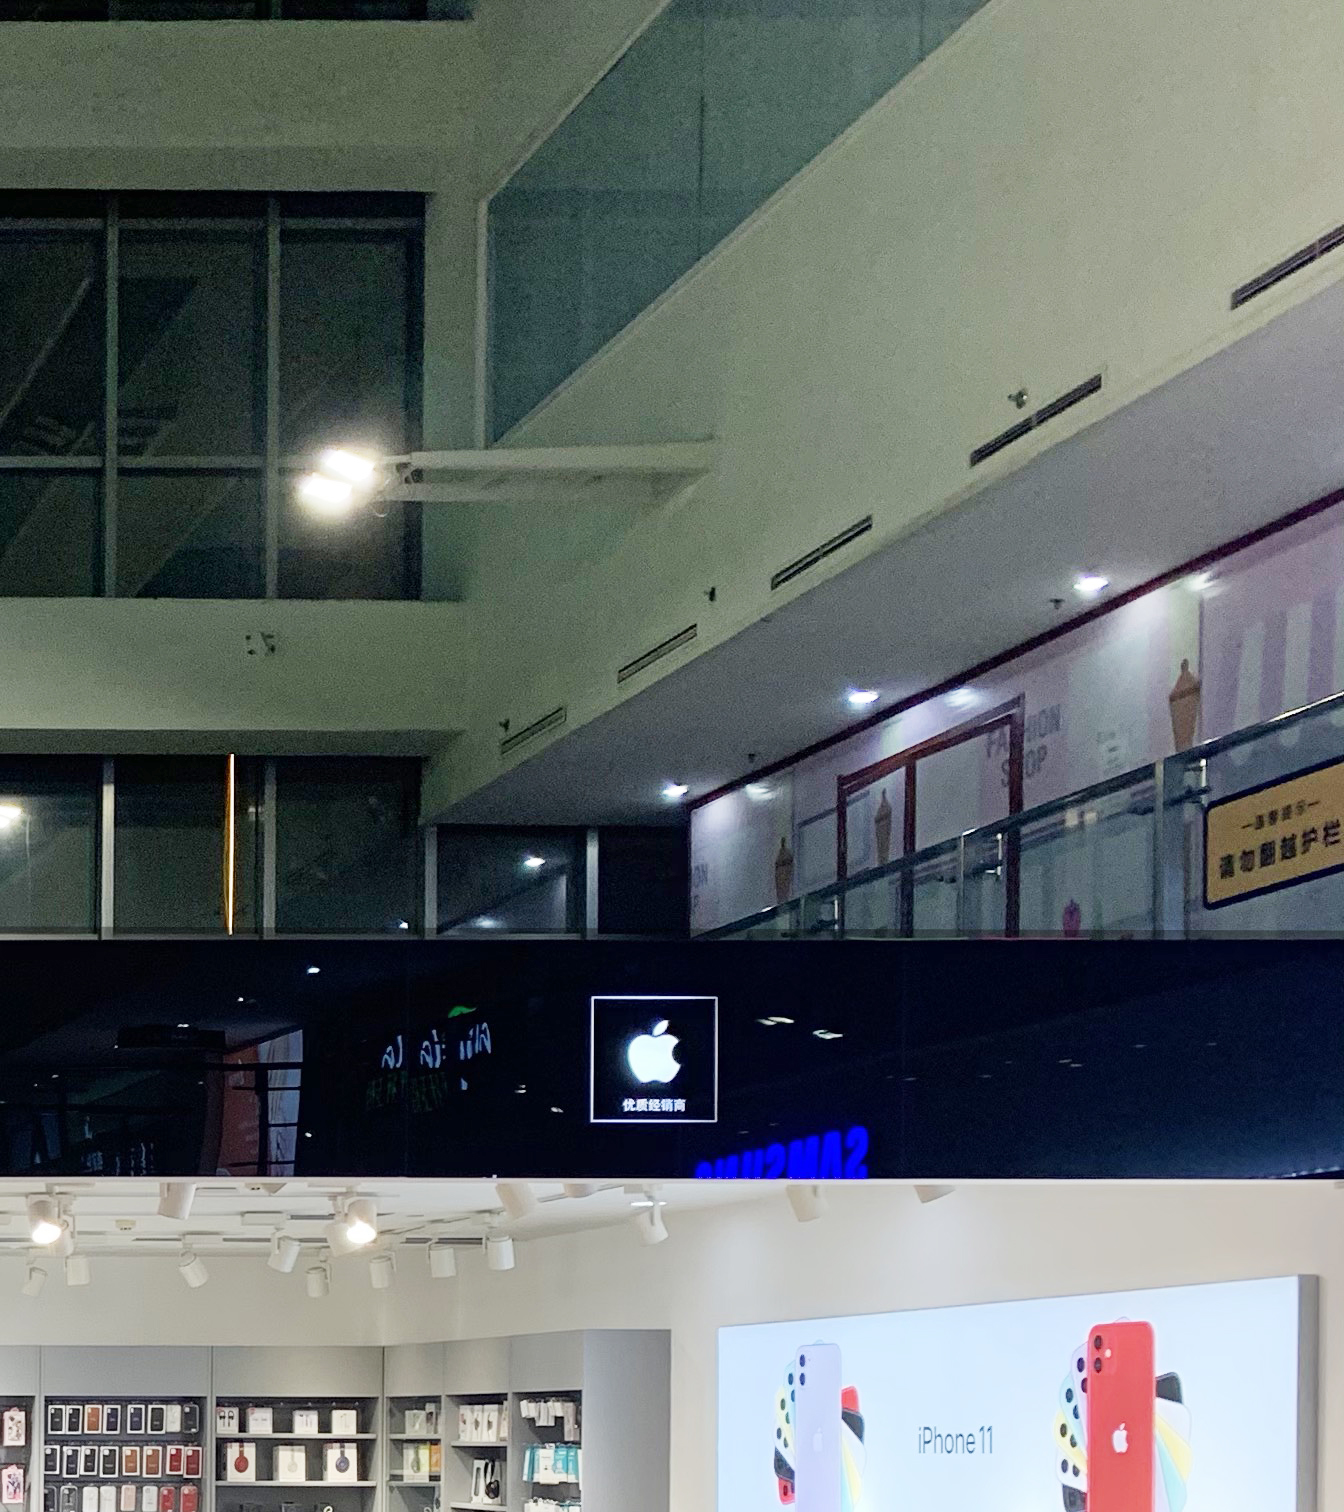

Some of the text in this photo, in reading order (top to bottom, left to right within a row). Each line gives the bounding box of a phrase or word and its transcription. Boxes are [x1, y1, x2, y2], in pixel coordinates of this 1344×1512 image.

[986, 703, 1061, 758] FAHION
[622, 1098, 686, 1112] 优质经销商
[918, 1425, 993, 1454] iPhone 11
